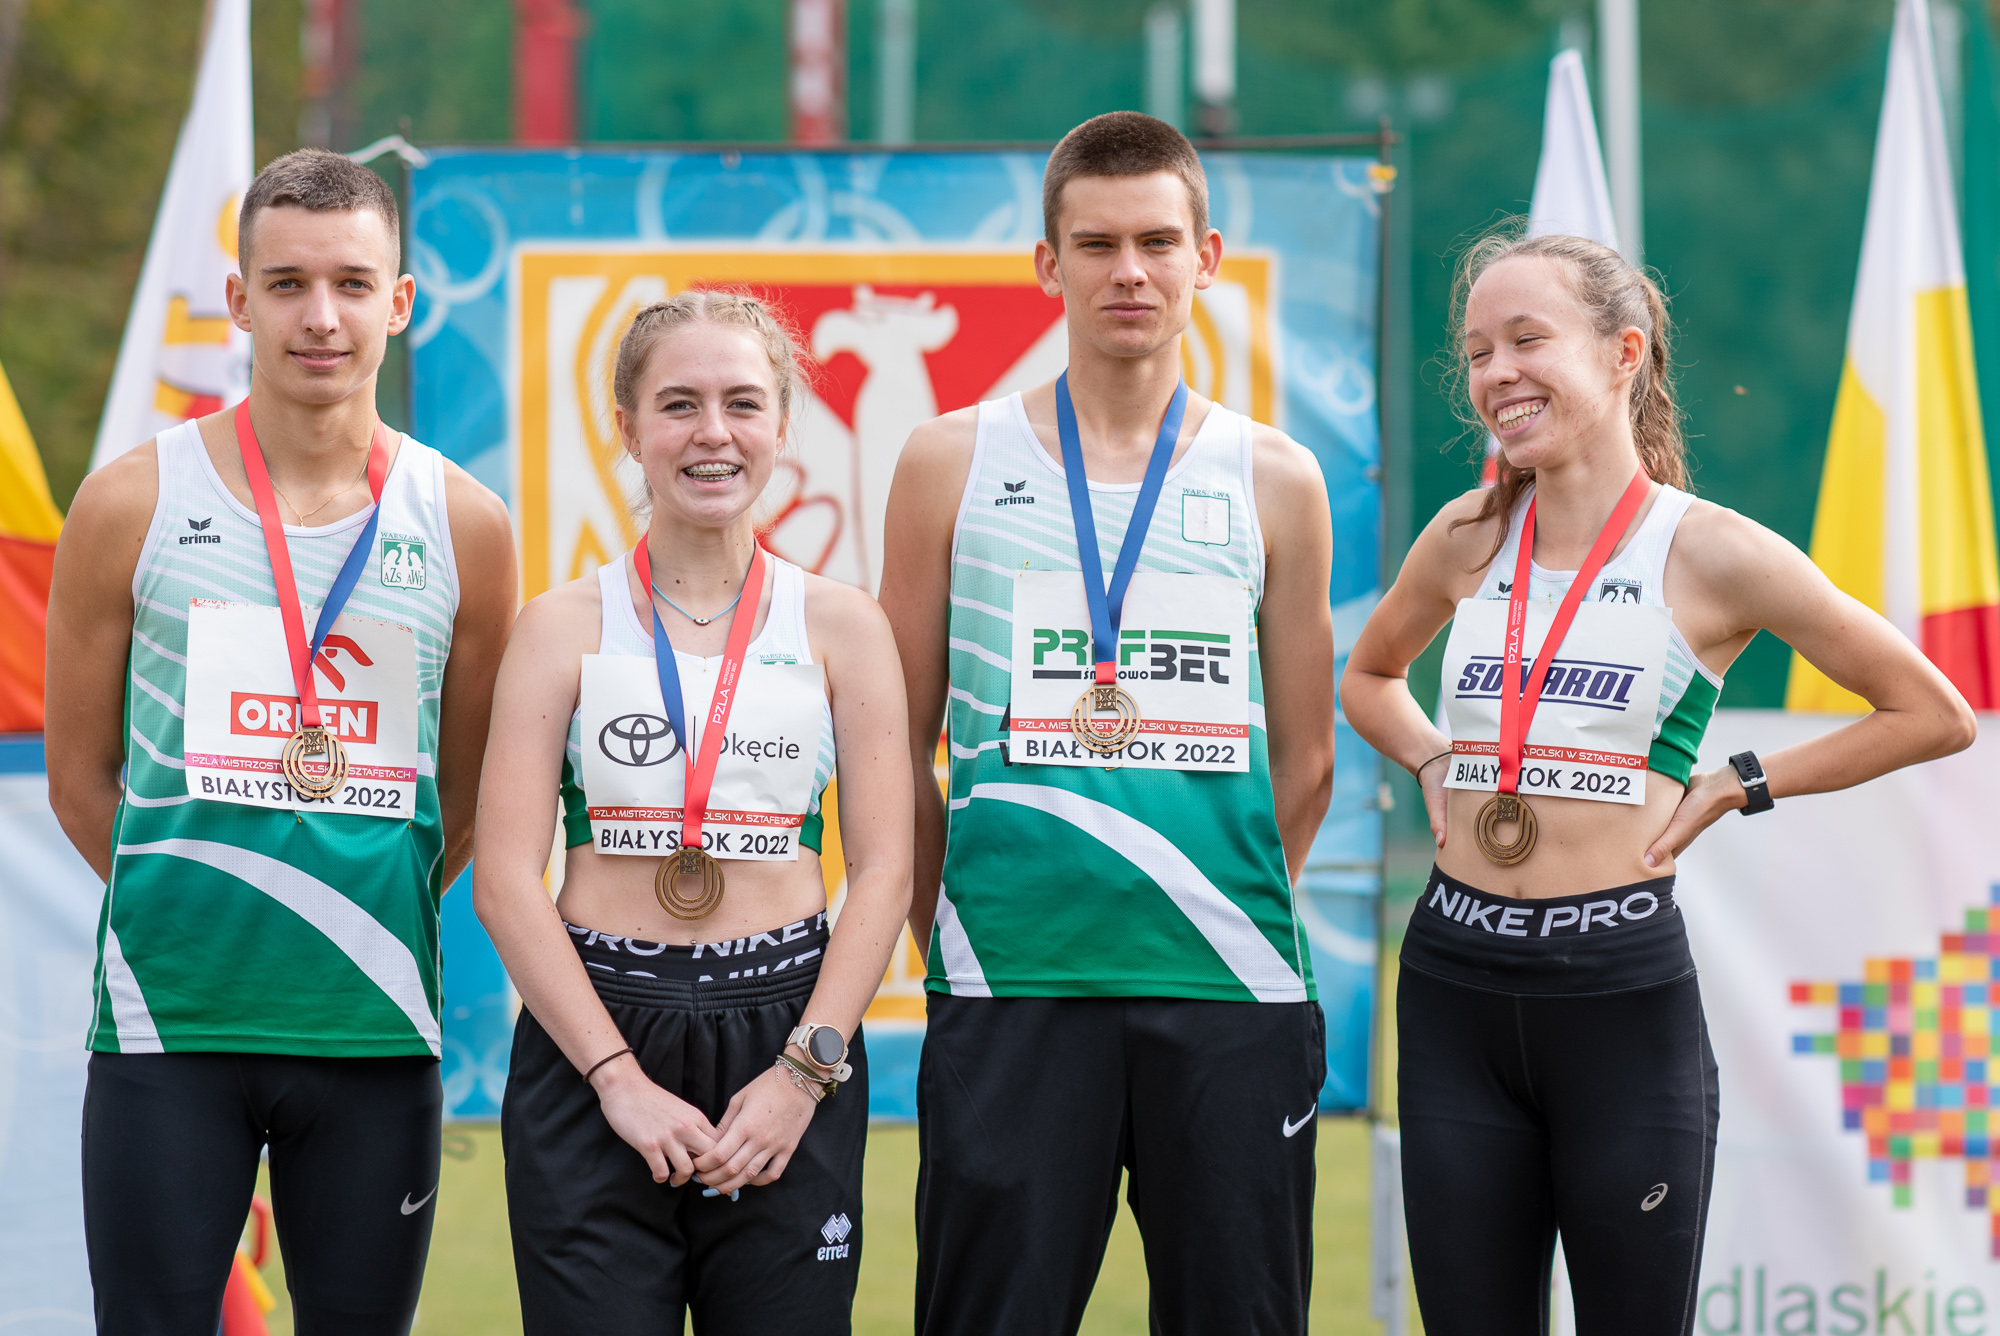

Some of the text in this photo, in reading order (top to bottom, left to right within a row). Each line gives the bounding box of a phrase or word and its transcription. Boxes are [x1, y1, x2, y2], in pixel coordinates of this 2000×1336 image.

[995, 495, 1034, 506] erima
[179, 534, 221, 545] erima
[381, 532, 426, 542] WARSZAWA
[384, 568, 424, 586] AZS AWF
[1033, 629, 1230, 685] PRFBET
[1508, 627, 1520, 664] PZLA
[712, 688, 731, 724] PZLA
[1018, 721, 1047, 730] PZLA
[1168, 723, 1179, 732] W
[1180, 724, 1244, 735] SZTAFETACH
[1174, 743, 1236, 764] 2022
[1455, 743, 1470, 752] PZLA
[1529, 748, 1564, 758] POLSKI
[1566, 750, 1578, 759] W
[1578, 752, 1642, 767] SZTAFETACH
[192, 756, 219, 766] PZLA
[348, 767, 411, 779] SZTAFETACH
[1455, 762, 1631, 796] BIAŁYTOK 2022
[343, 785, 401, 809] 2022
[593, 809, 618, 817] PZLA
[618, 809, 685, 819] MISTRZOSTW
[702, 812, 731, 822] OLSKI
[733, 813, 744, 822] W
[601, 828, 789, 855] BIAŁYSOK 2022
[1428, 882, 1659, 937] NIKE PRO
[691, 920, 809, 959] NIKE
